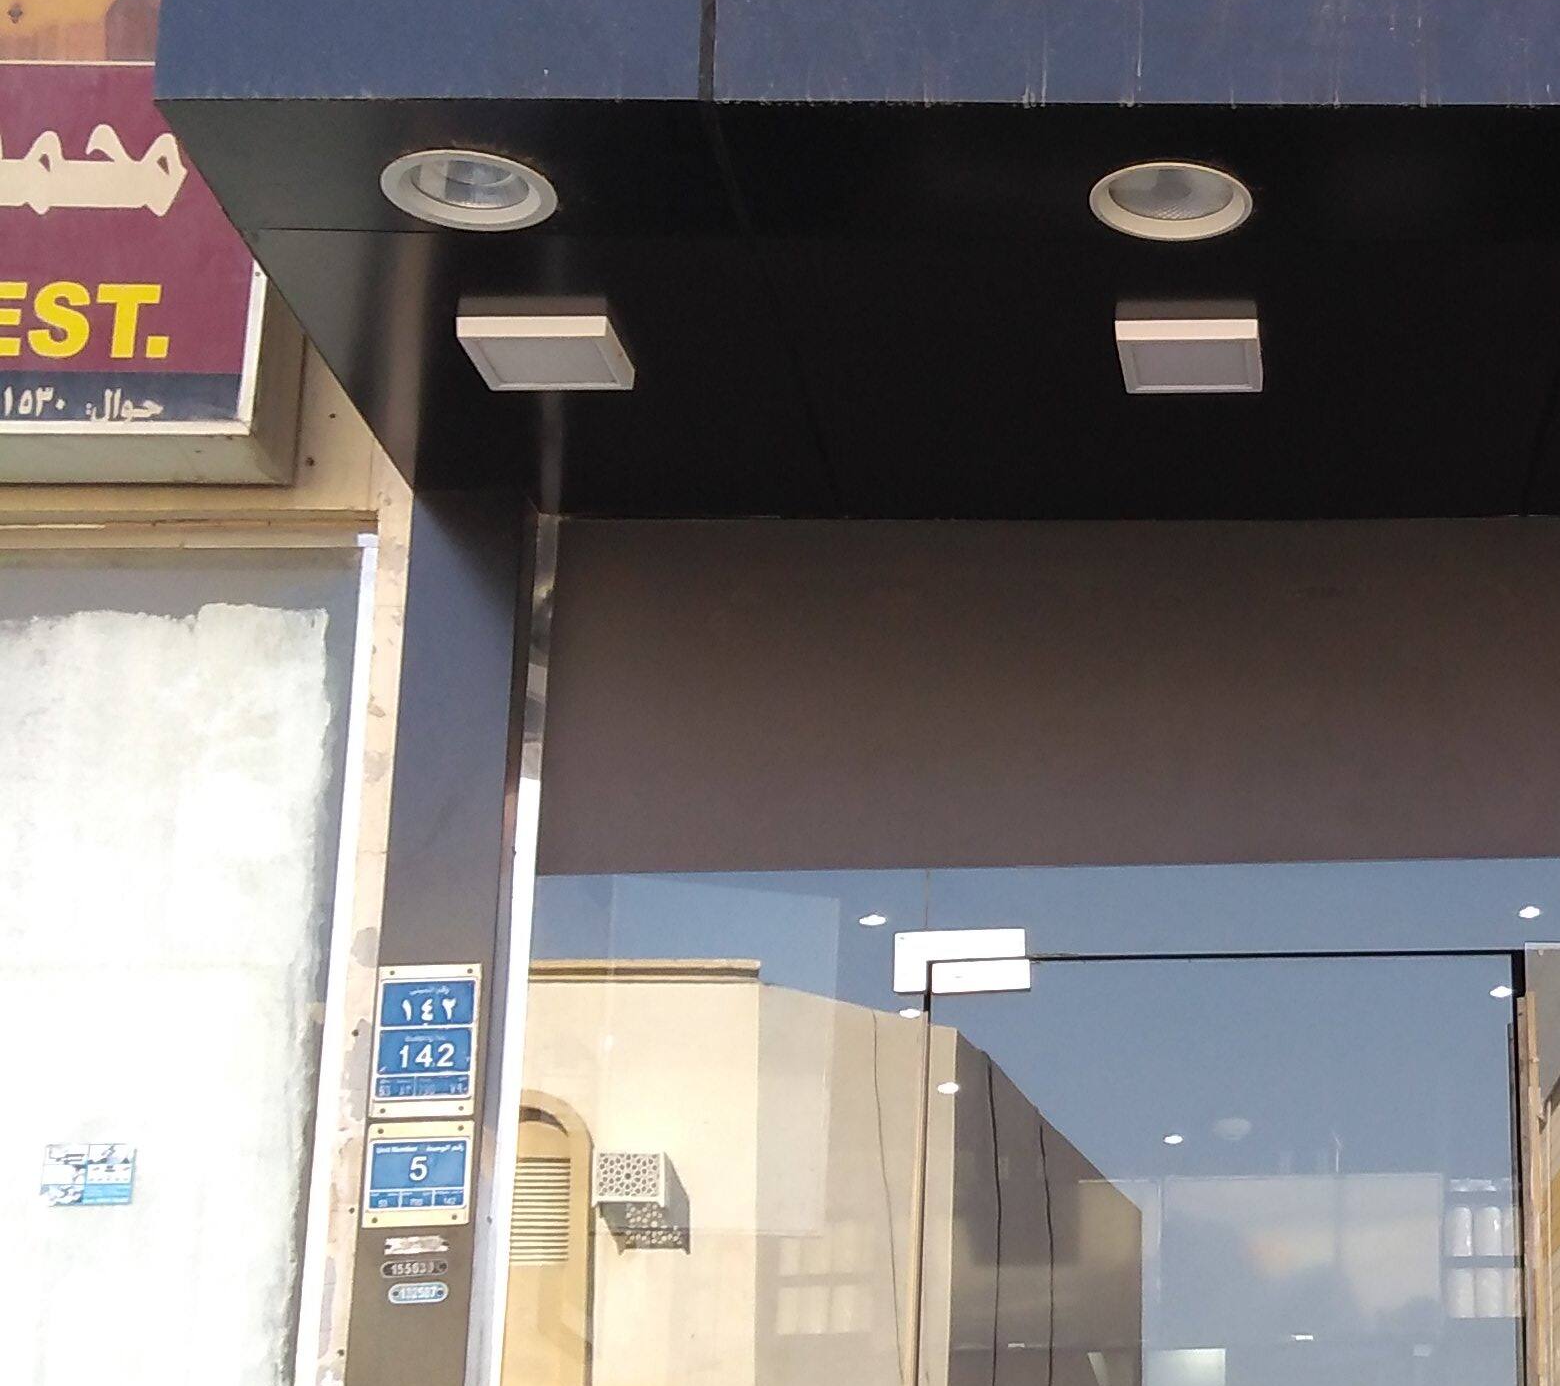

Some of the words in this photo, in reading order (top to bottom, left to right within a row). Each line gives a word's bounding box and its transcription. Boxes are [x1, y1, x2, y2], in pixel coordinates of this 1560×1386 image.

[0, 124, 188, 217] محم
[402, 998, 456, 1022] ١٤٢
[399, 1043, 455, 1068] 142
[409, 1156, 428, 1181] 5
